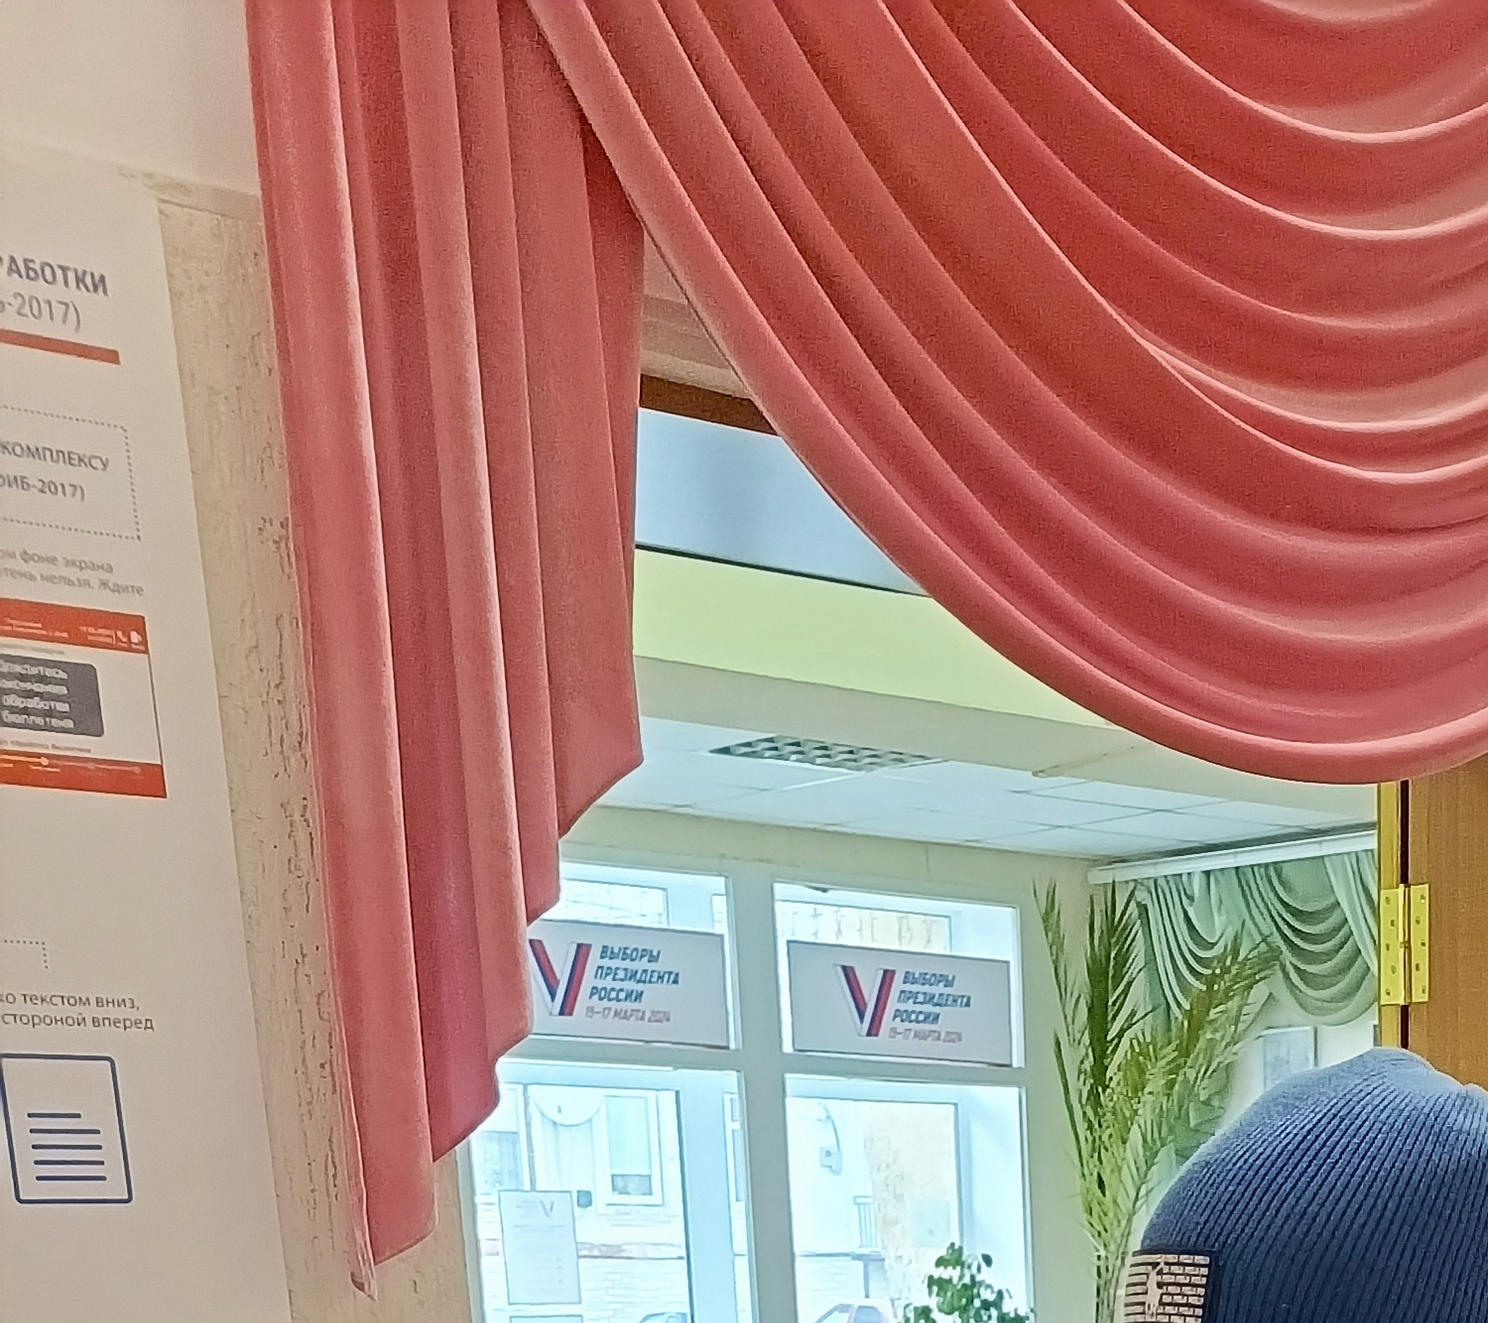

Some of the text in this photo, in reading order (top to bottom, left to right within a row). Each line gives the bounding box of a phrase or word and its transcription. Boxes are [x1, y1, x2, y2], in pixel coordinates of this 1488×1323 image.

[600, 944, 662, 963] ВЫБОРЫ
[594, 965, 680, 986] ПРЕЗИДЕНТА
[902, 970, 956, 988] ВЫБОРЫ
[21, 993, 91, 1007] текстом
[95, 996, 140, 1010] вниз,
[588, 986, 645, 1004] РОССИИ
[896, 989, 972, 1008] ПРЕЗИДЕНТА
[1, 1012, 154, 1031] стороной вперед
[892, 1009, 941, 1025] РОССИИ
